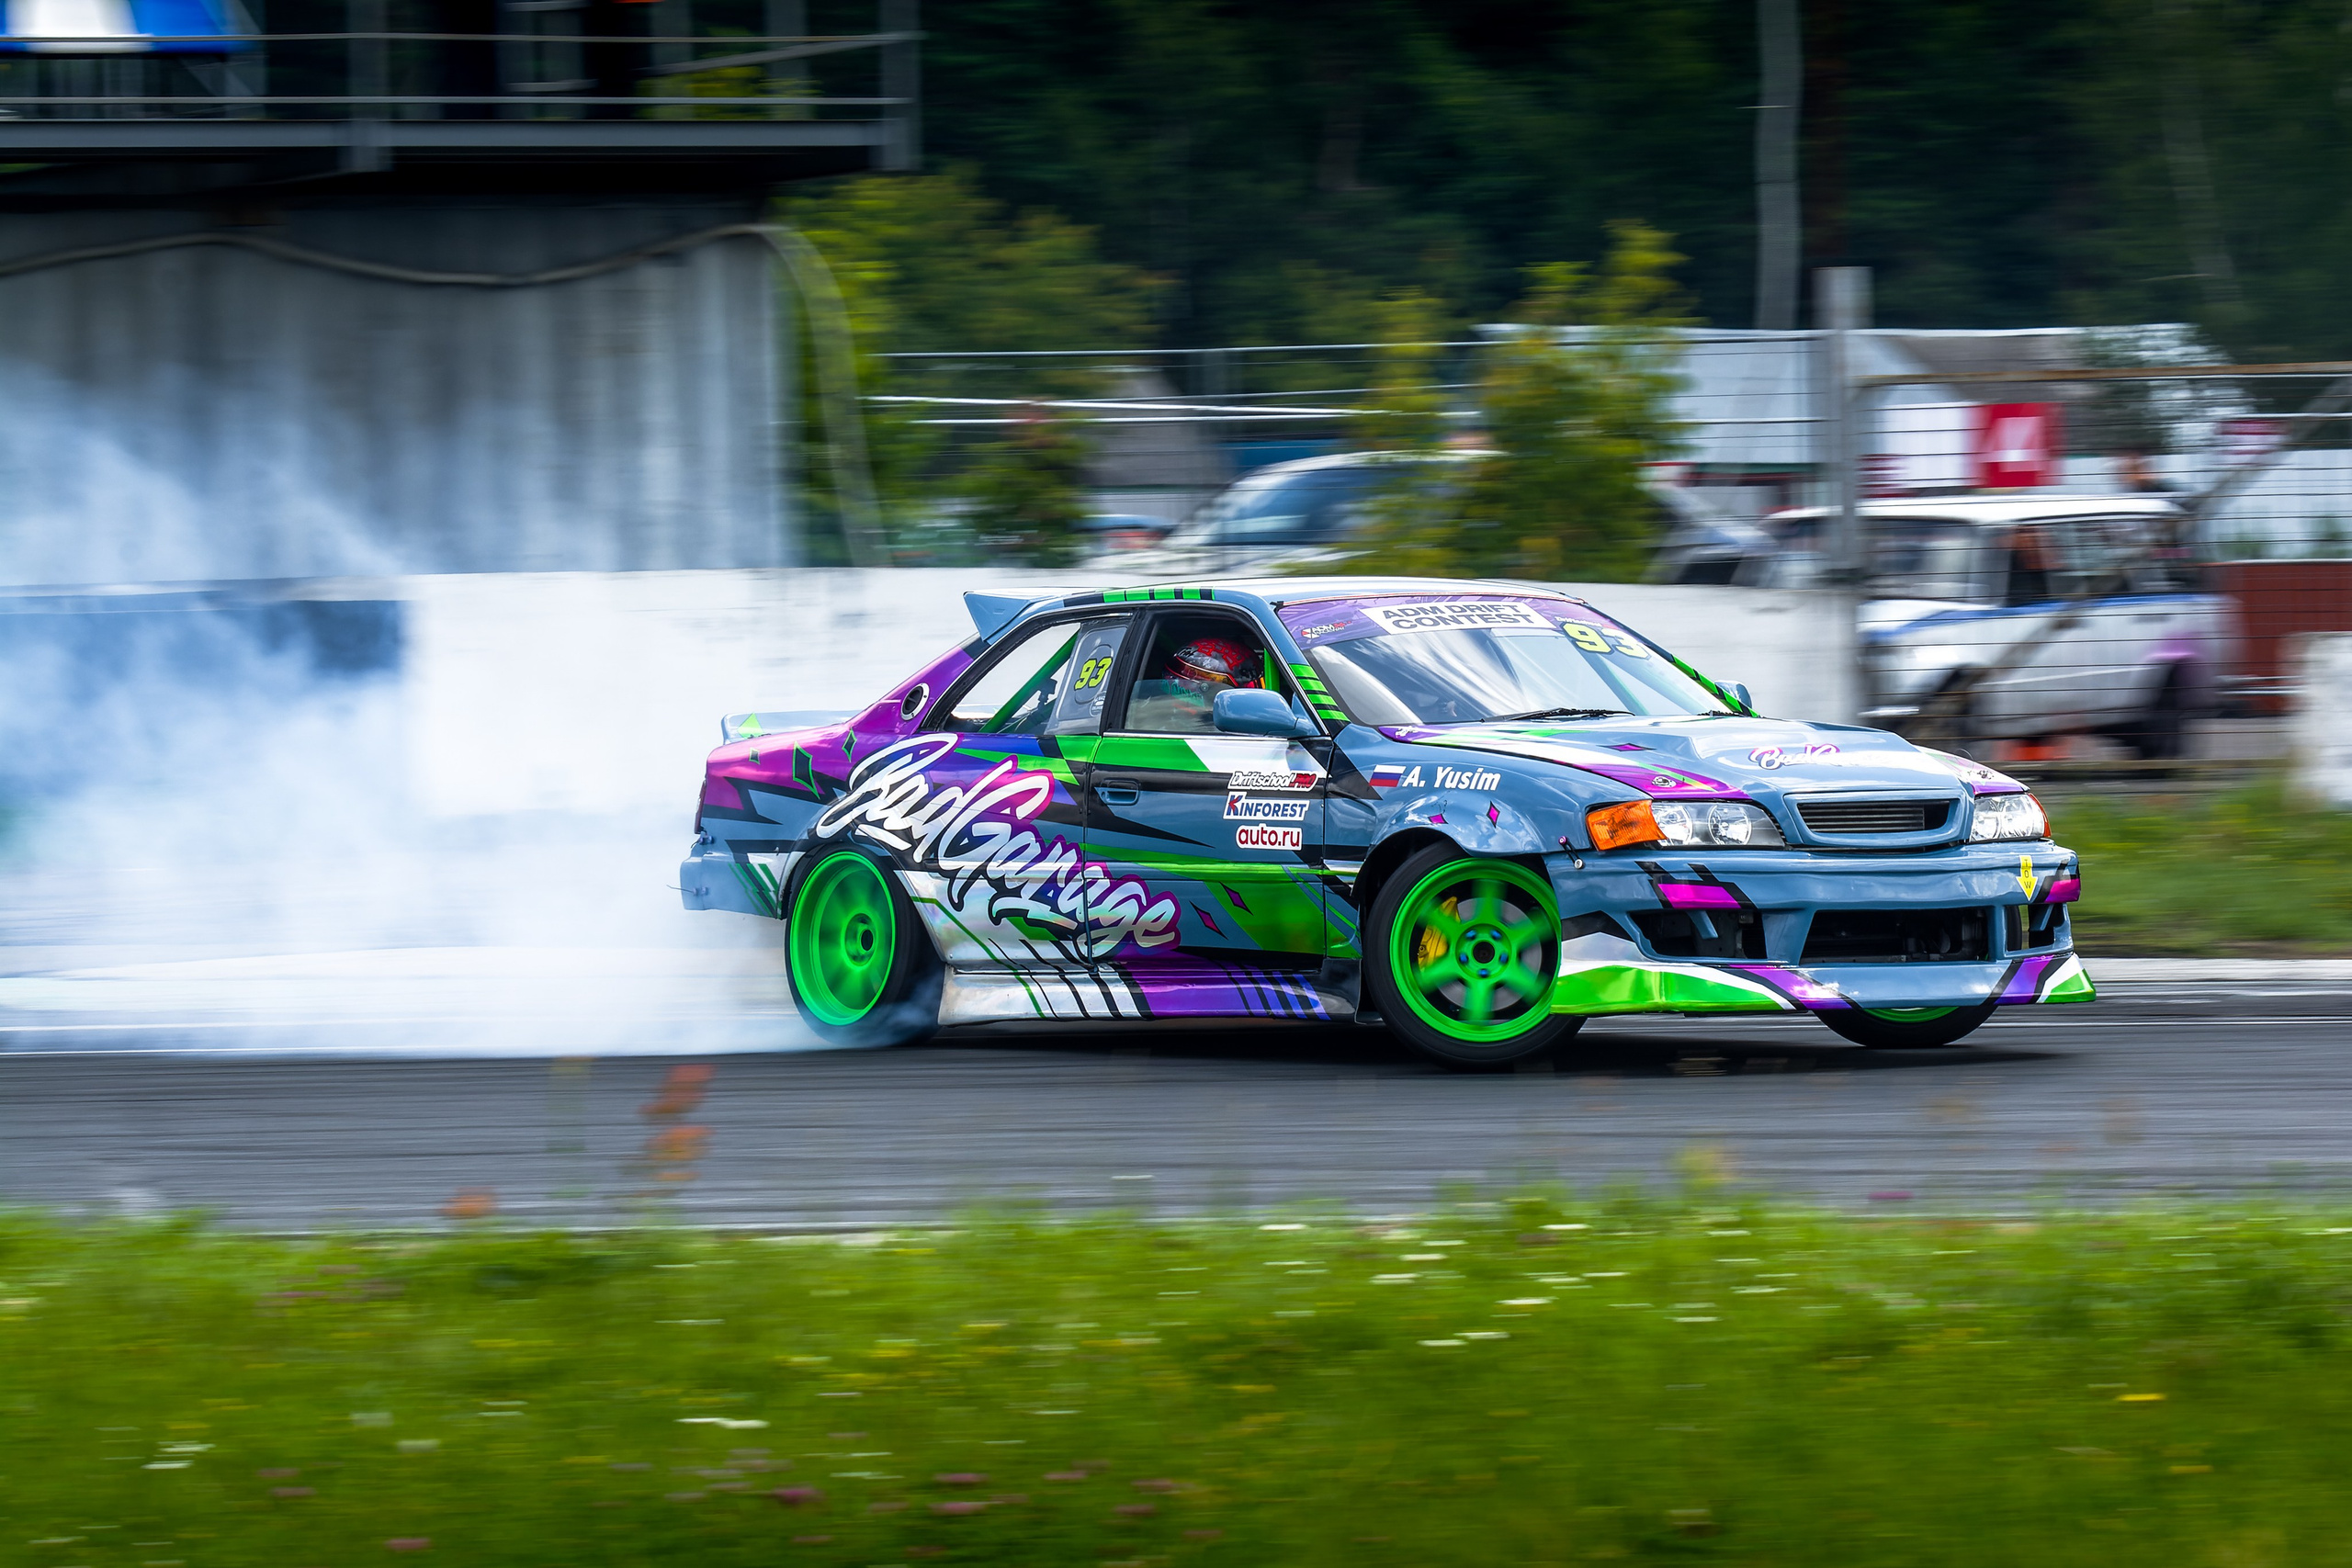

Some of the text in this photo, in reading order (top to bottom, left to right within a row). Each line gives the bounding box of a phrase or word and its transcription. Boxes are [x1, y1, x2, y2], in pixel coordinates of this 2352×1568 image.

[1383, 604, 1521, 619] ADM DRIFT
[1392, 614, 1534, 629] CONTEST
[1561, 622, 1651, 660] 93
[1074, 656, 1114, 691] 93
[1402, 765, 1501, 791] A. Yusim
[1226, 794, 1307, 818] KINFOREST
[1238, 826, 1301, 848] auto.ru
[2023, 858, 2032, 889] TOW
